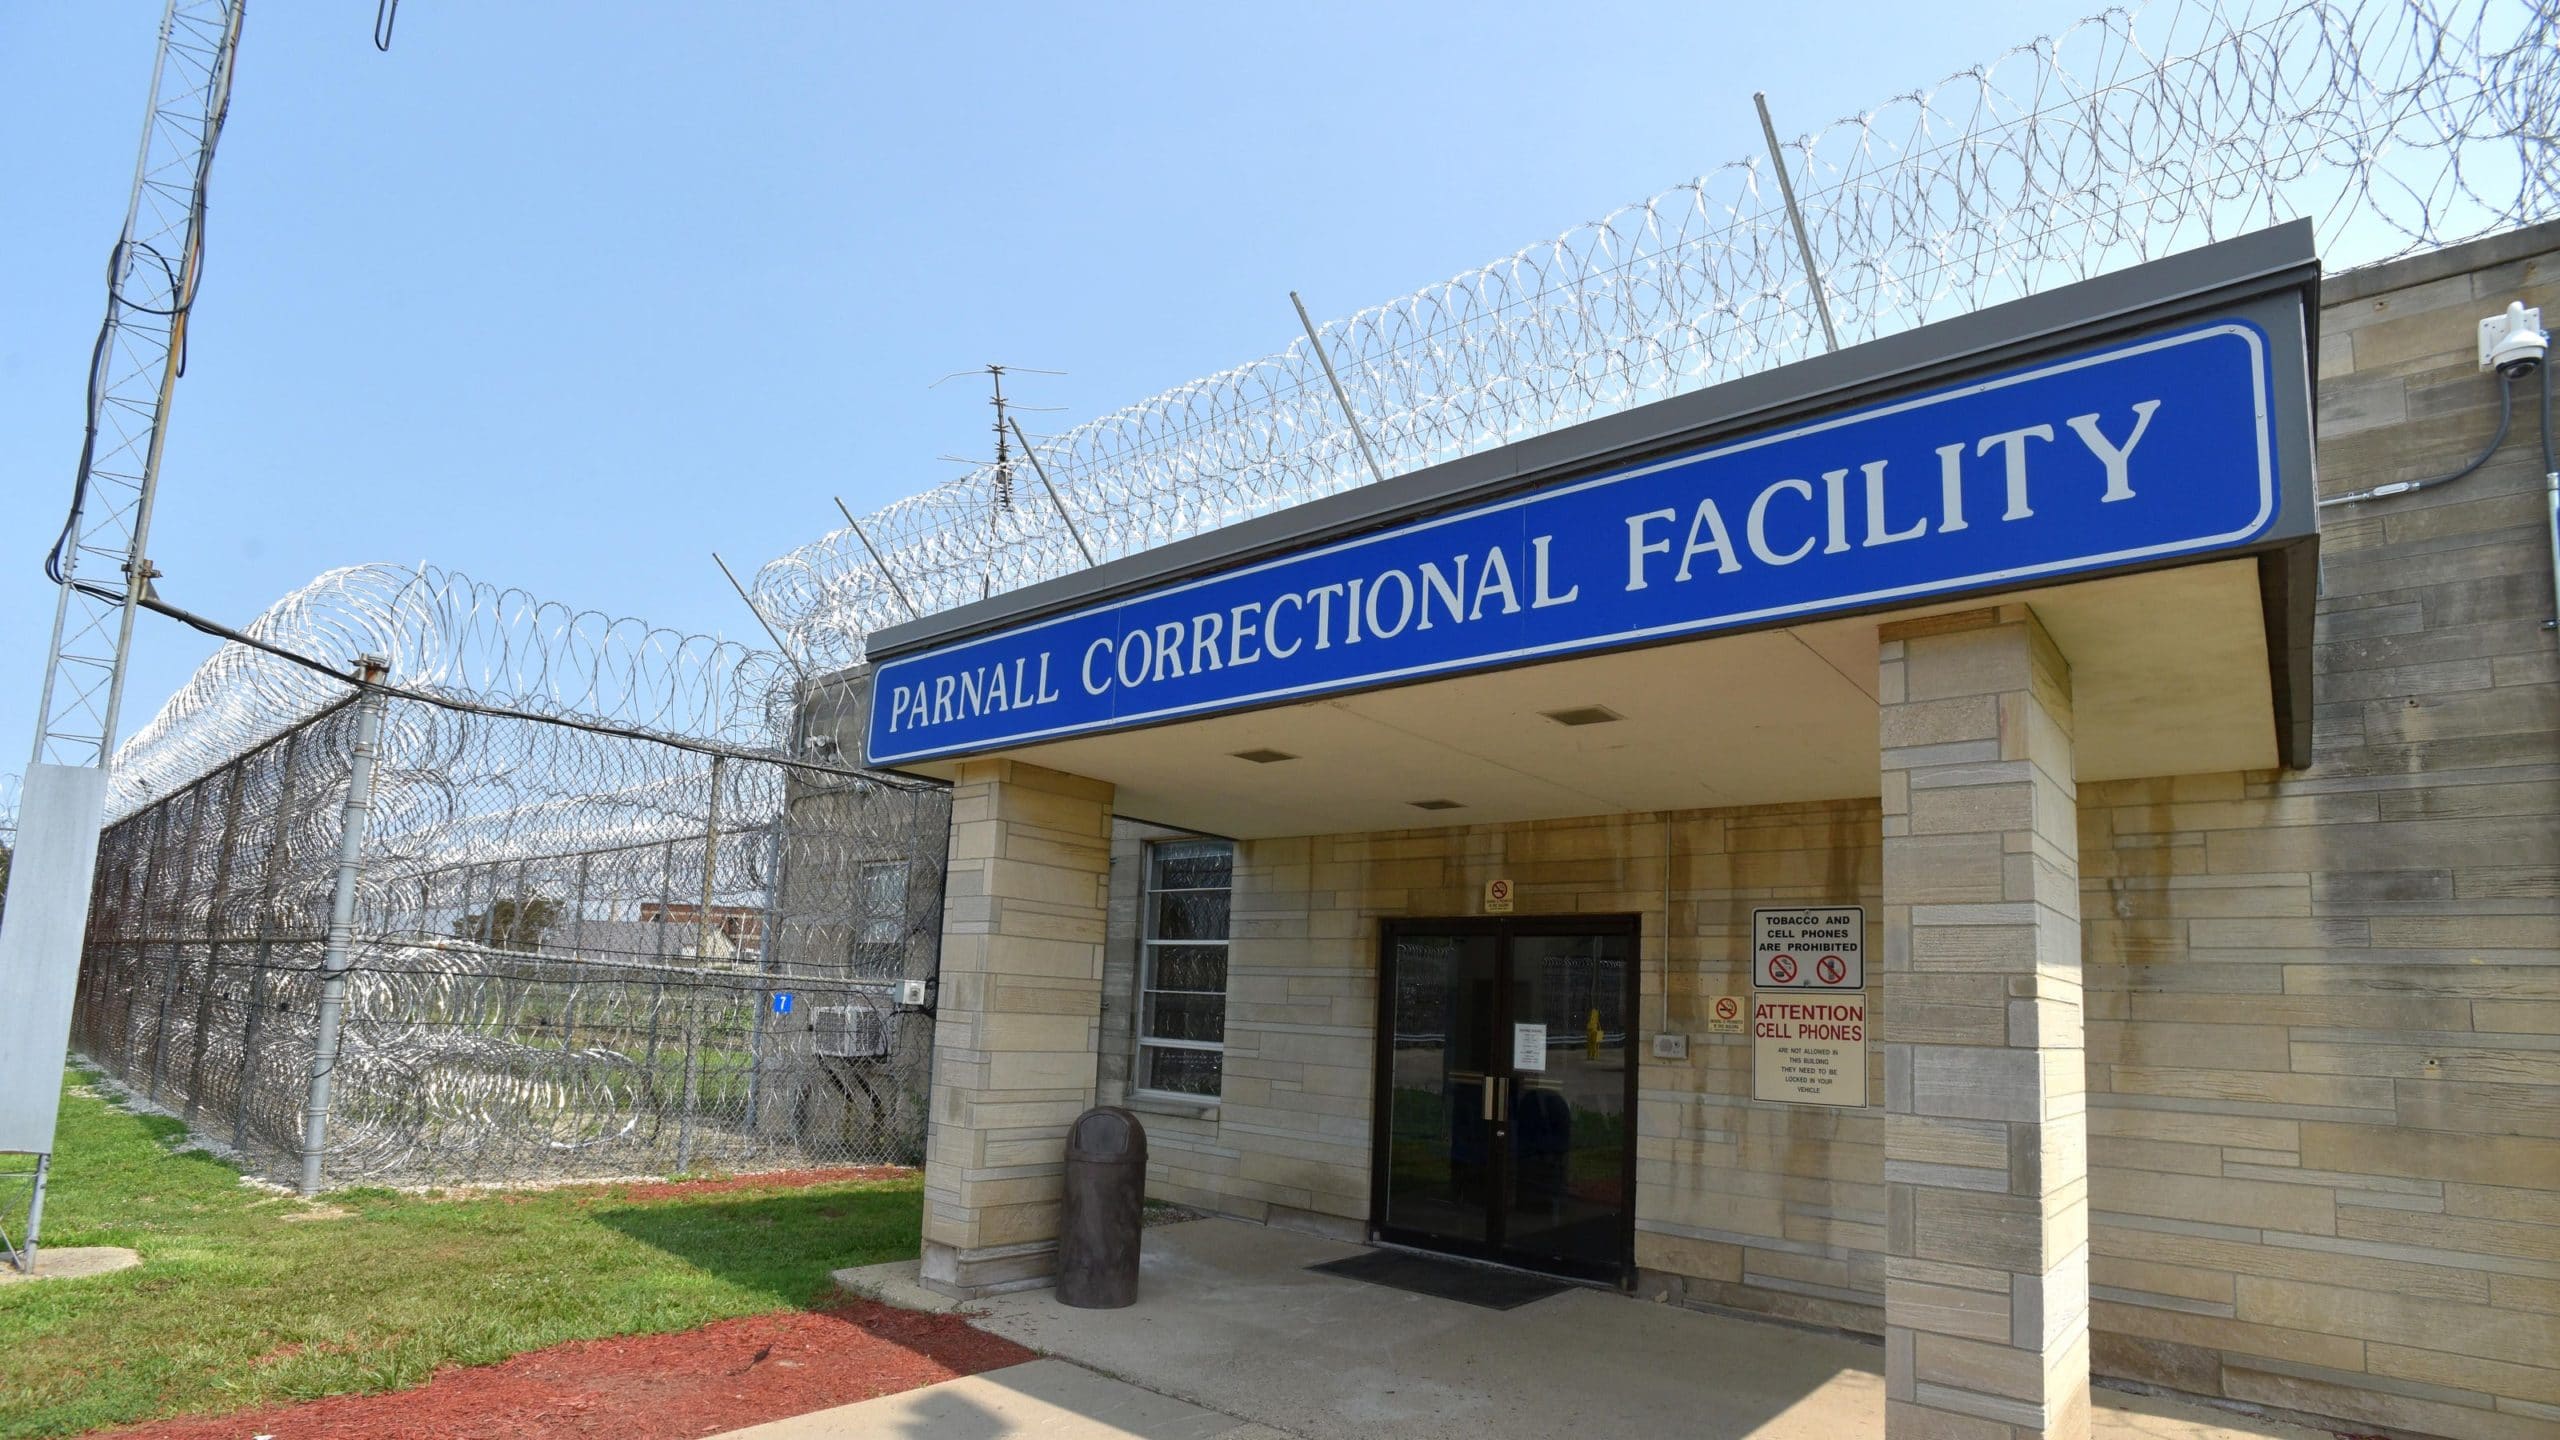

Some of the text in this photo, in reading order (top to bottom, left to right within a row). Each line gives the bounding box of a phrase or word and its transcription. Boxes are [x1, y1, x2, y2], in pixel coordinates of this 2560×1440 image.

[889, 399, 2162, 733] PARNALL CORRECTIONAL FACILITY
[1766, 916, 1850, 925] TOBACCO AND
[1767, 929, 1849, 938] CELL PHONES
[1759, 943, 1858, 952] ARE PROHIBITED
[780, 996, 786, 1010] 7
[1755, 1004, 1863, 1021] ATTENTION
[1755, 1022, 1862, 1041] CELL PHONES
[1818, 1077, 1833, 1085] YOUR
